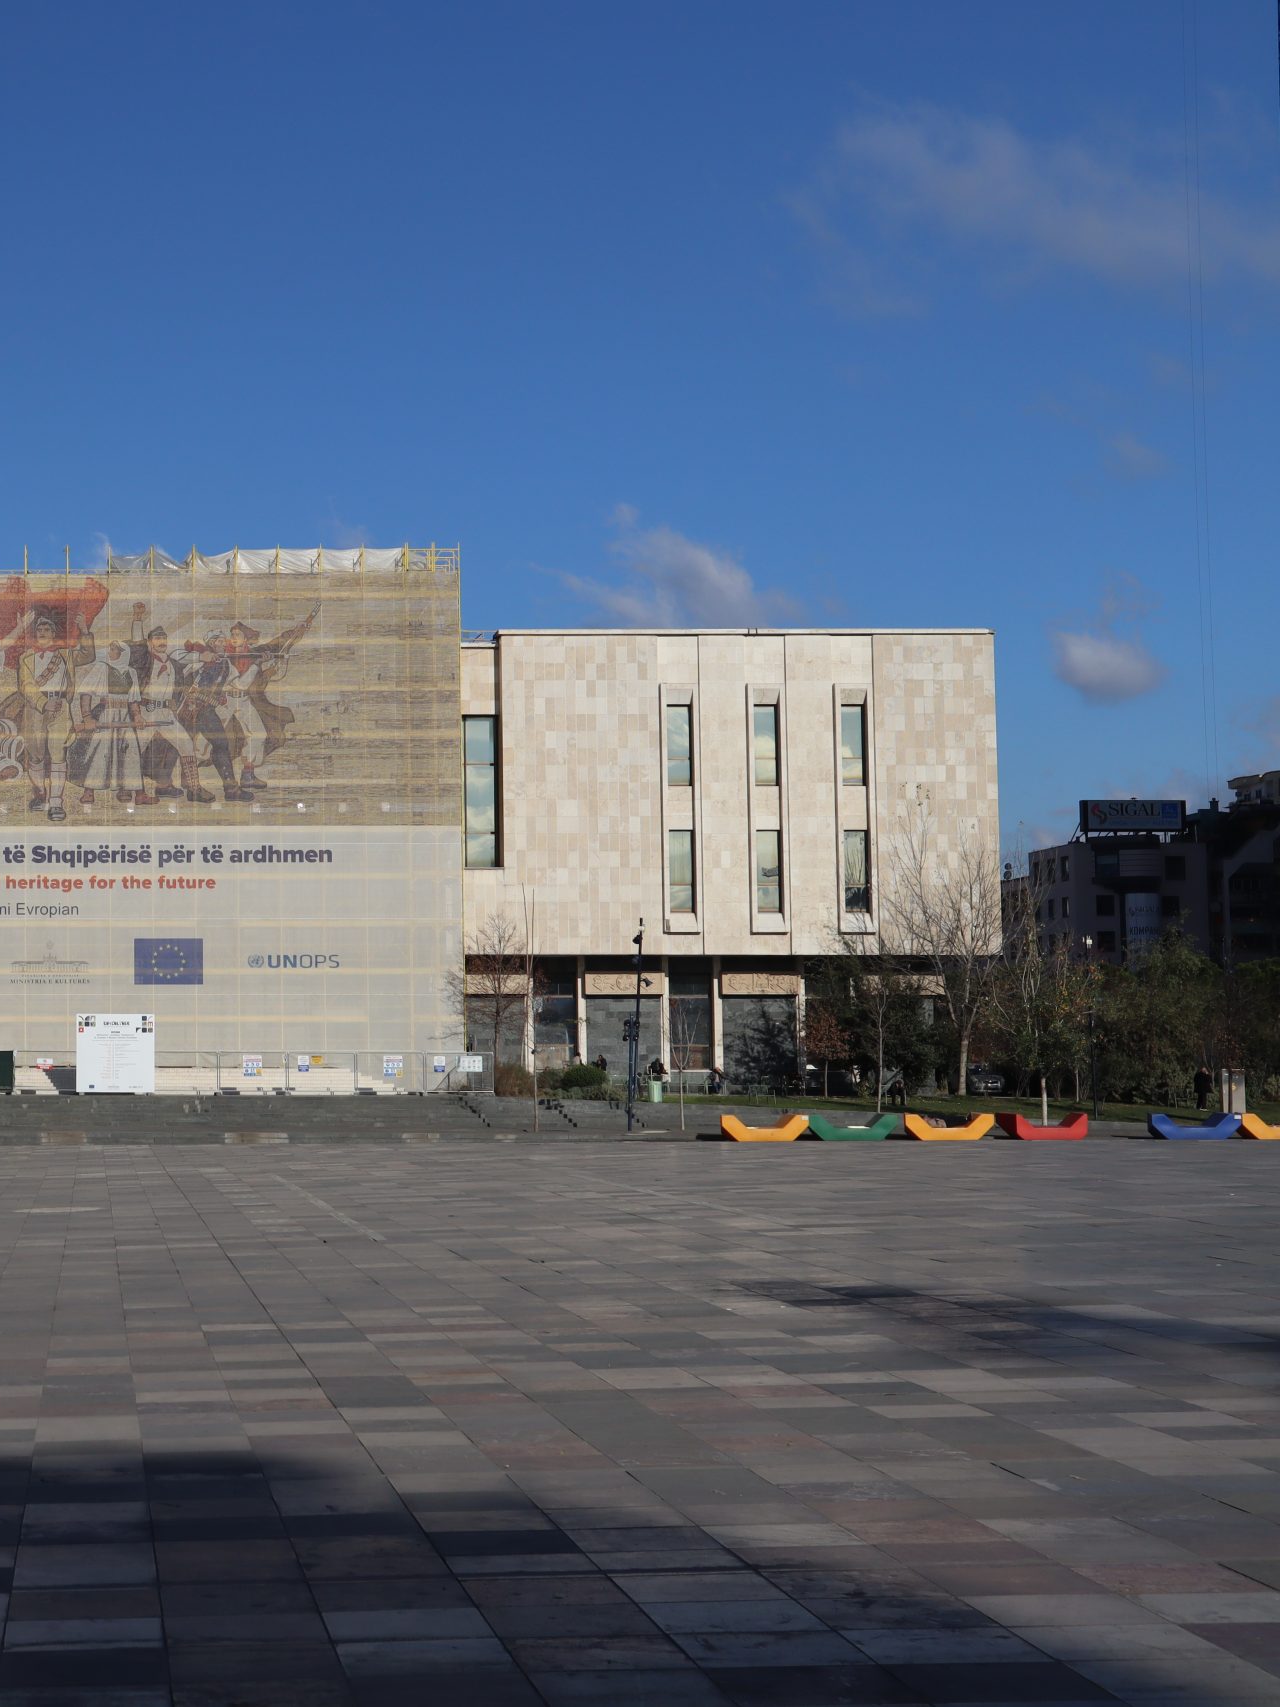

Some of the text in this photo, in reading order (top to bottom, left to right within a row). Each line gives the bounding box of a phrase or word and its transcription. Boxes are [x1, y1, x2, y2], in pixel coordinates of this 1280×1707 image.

[1108, 802, 1161, 817] SIGAL
[3, 845, 26, 864] të
[31, 844, 153, 868] Shqipërisë
[158, 845, 196, 868] për
[200, 845, 224, 864] të
[229, 844, 333, 864] ardhmen
[5, 874, 84, 892] heritage
[89, 875, 116, 889] for
[122, 875, 153, 889] the
[158, 874, 216, 889] future
[16, 902, 79, 918] Evropian
[267, 954, 340, 969] UNOPS
